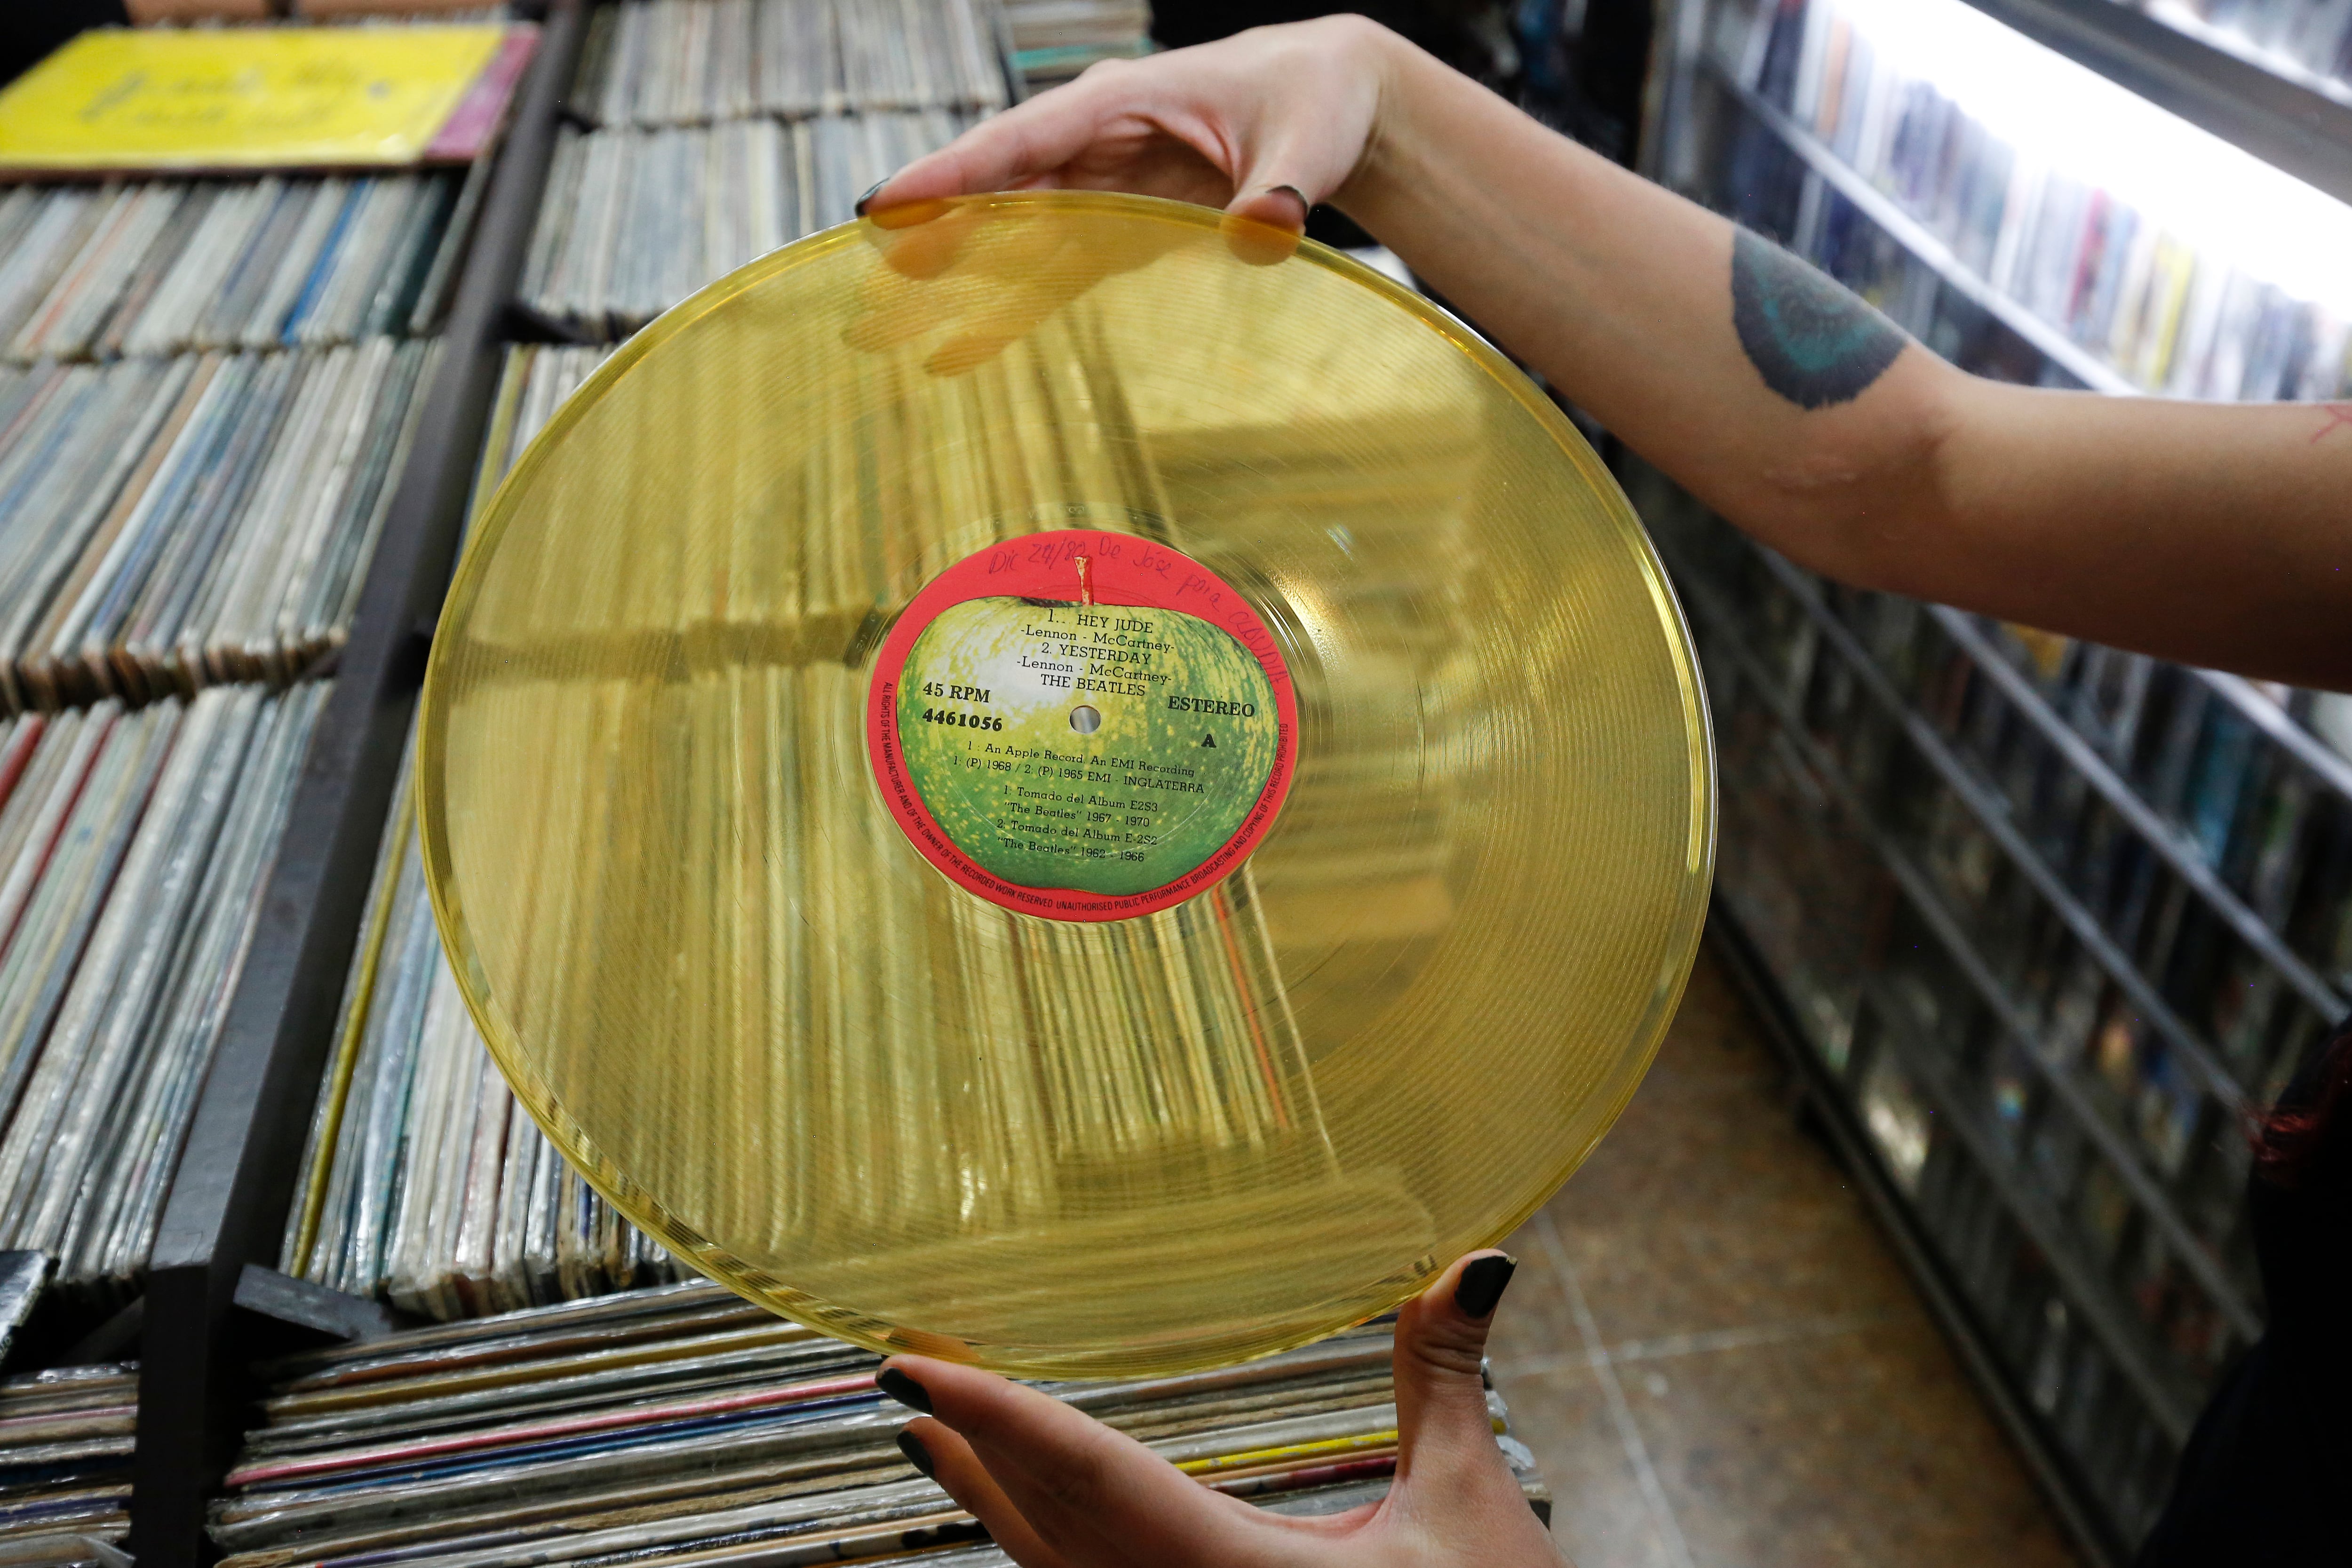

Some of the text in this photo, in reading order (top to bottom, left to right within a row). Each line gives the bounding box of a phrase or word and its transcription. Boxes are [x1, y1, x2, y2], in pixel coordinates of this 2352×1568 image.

[1077, 614, 1109, 628] HEY
[1114, 619, 1153, 633] JUDE
[1021, 625, 1077, 640] -Lennon
[1093, 632, 1175, 653] McCartney-
[1041, 642, 1152, 665] 2. YESTERDAY
[1017, 656, 1073, 672] -Lennon
[1089, 663, 1171, 685] McCartney-
[883, 682, 893, 693] ALL
[922, 682, 991, 703] 45 RPM
[1041, 674, 1145, 696] THE BEATLES
[881, 695, 890, 718] RIGHTS
[1168, 695, 1255, 717] ESTEREO
[922, 708, 1002, 732] 4461056
[882, 729, 890, 741] THE
[1201, 733, 1216, 748] A
[883, 743, 905, 795] MANUFACTURER
[985, 743, 1001, 754] An
[1005, 746, 1040, 759] Apple
[1090, 756, 1106, 766] An
[1111, 758, 1134, 769] EMI
[1139, 761, 1194, 777] Recording
[954, 756, 961, 765] 1:
[966, 757, 981, 769] (P)
[987, 760, 1011, 771] 1968
[1015, 764, 1021, 772] /
[1025, 764, 1033, 774] 2:
[1038, 766, 1054, 778] (P)
[1059, 768, 1083, 780] 1965
[1087, 772, 1111, 783] EMI
[1123, 775, 1204, 794] INGLATERRA
[898, 795, 912, 810] AND
[1004, 785, 1158, 812] 1: Tomado del Album E2S3
[907, 808, 918, 817] OF
[913, 817, 926, 830] THE
[1057, 724, 1288, 911] UNAUTHORISED PUBLIC PERFORMANCE BROADCASTING AND COPYING OF THIS RECORD PROHIBITED
[1087, 812, 1112, 823] 1967
[1125, 816, 1150, 827] 1970
[922, 828, 944, 851] OWNER
[997, 819, 1158, 845] 2: Tomado del Album E-2S2
[941, 849, 952, 858] OF
[949, 855, 963, 868] THE
[1081, 847, 1105, 859] 1962
[1120, 851, 1144, 862] 1966
[961, 864, 995, 889] RECORDED
[995, 883, 1017, 898] WORK
[1017, 891, 1053, 908] RESERVED
